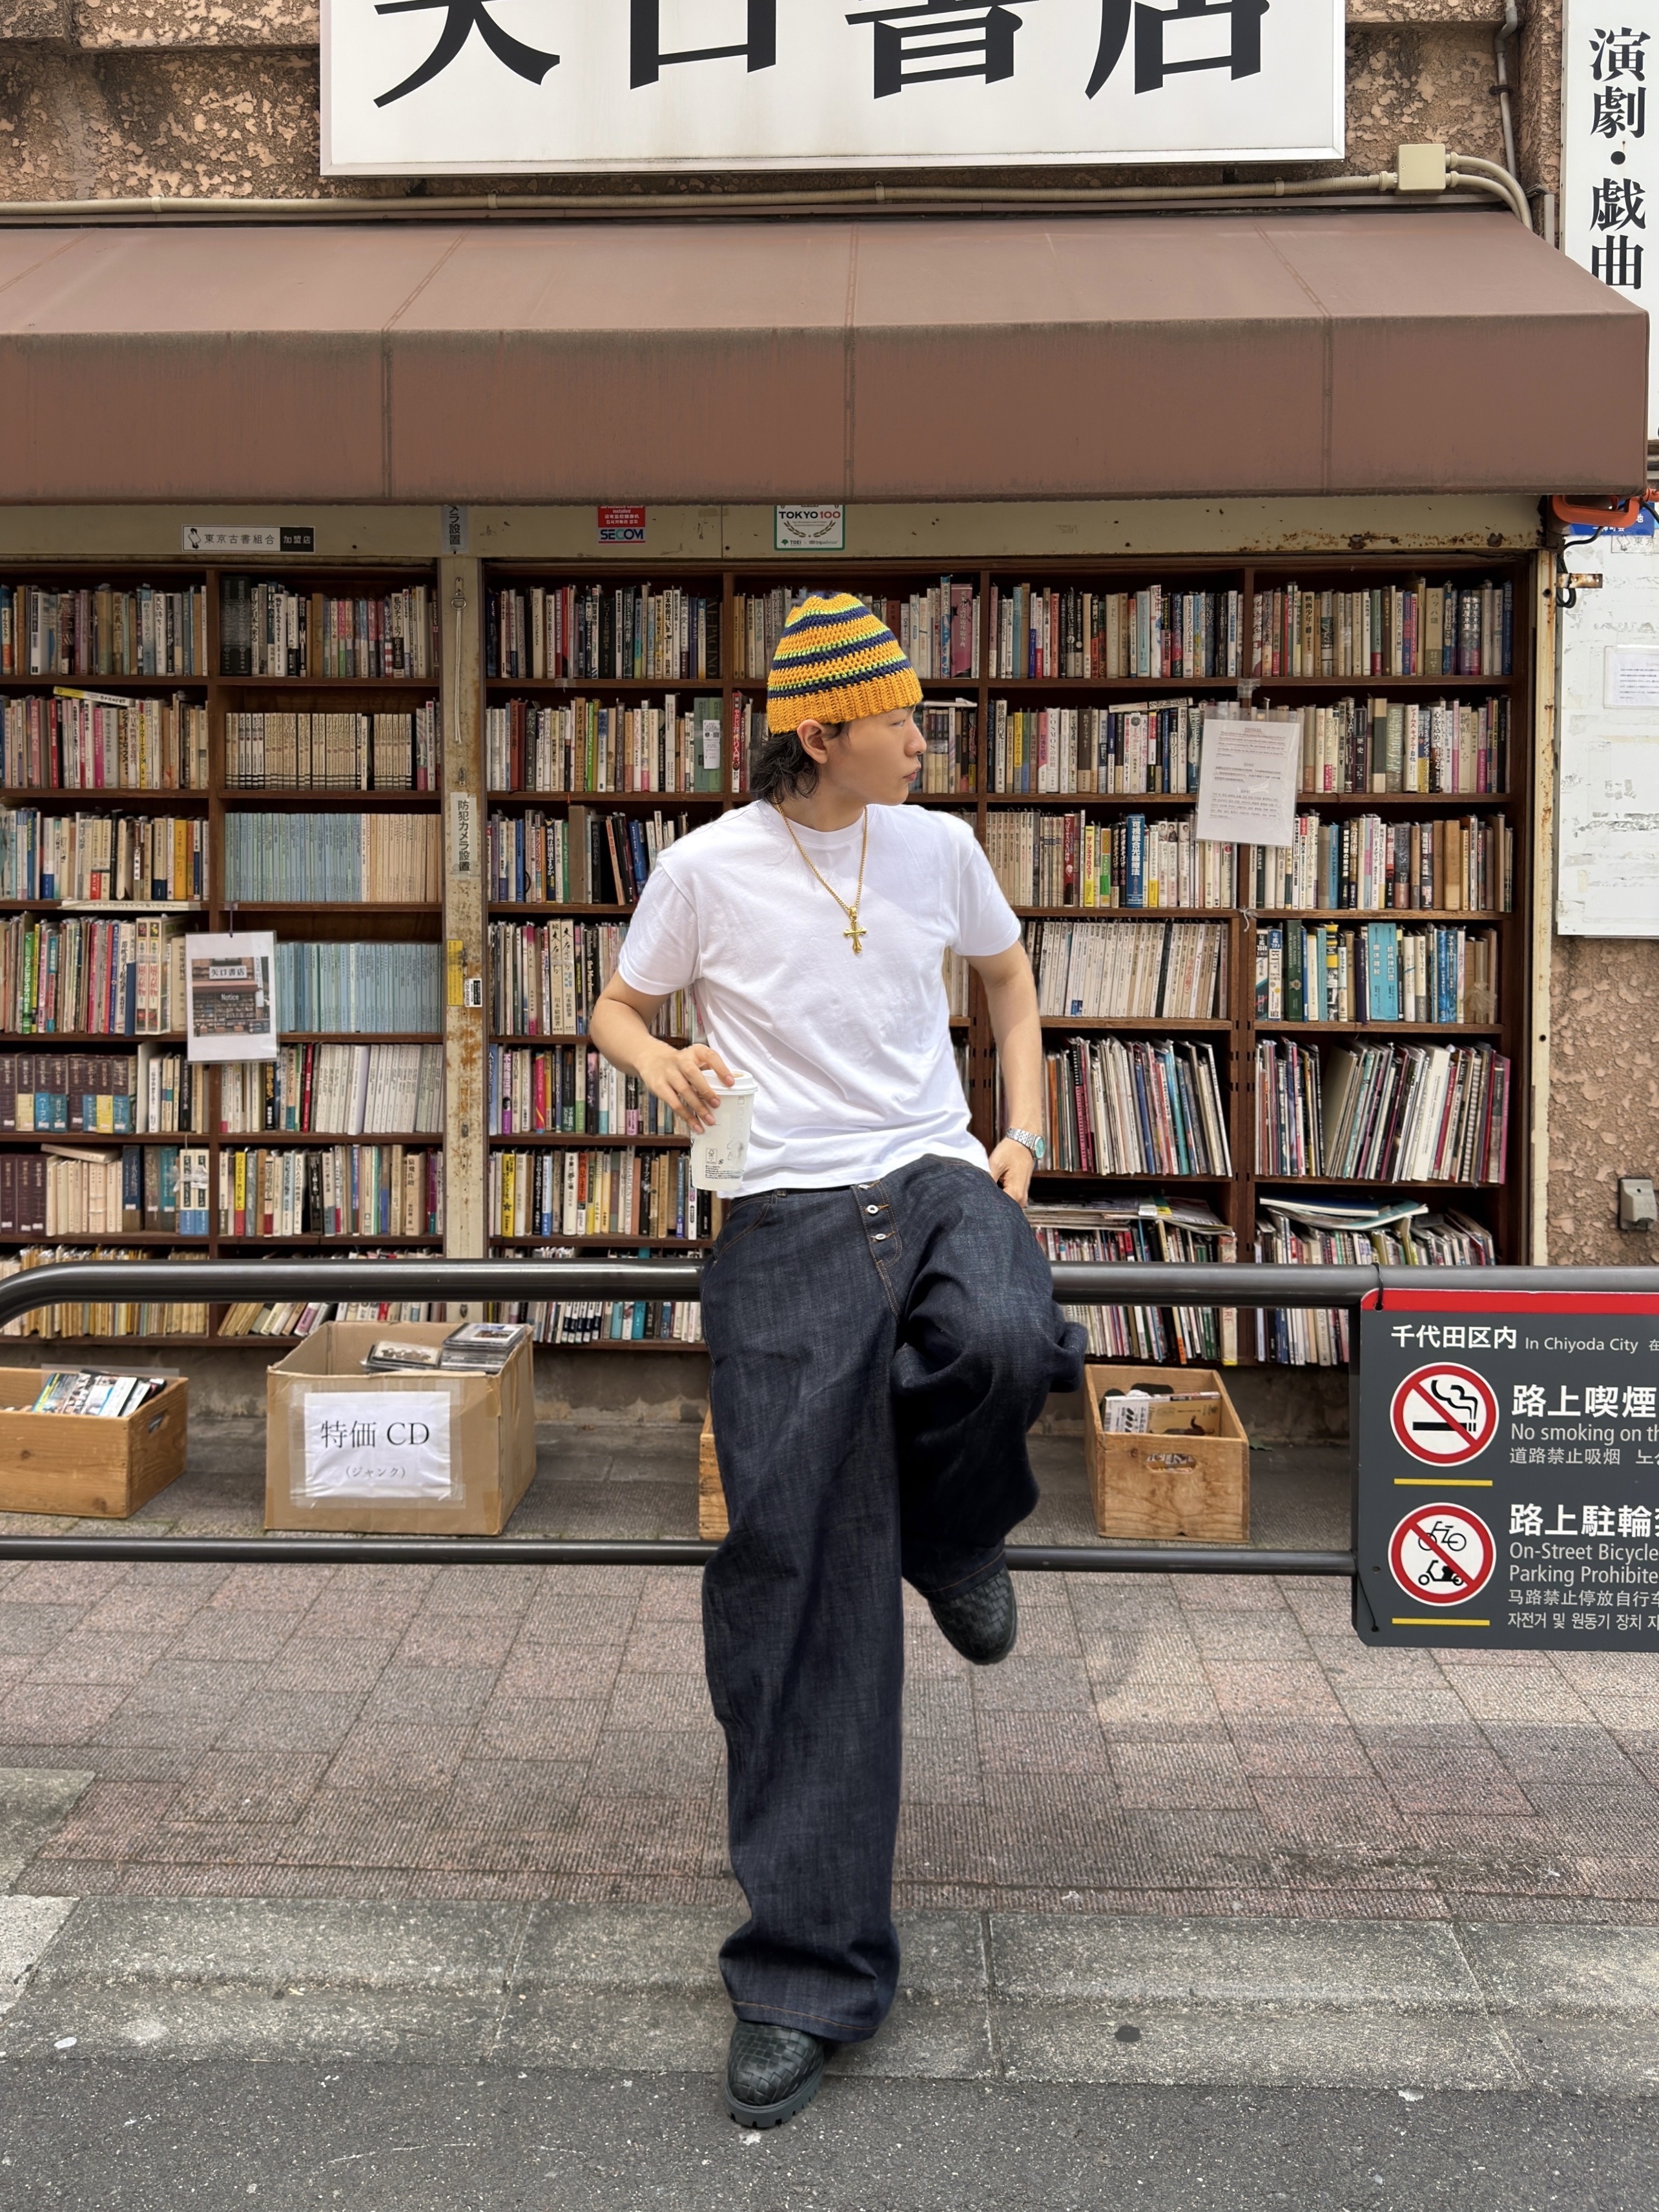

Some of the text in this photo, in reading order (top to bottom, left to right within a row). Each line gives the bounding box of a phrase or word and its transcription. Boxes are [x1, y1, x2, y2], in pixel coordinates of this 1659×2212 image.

[1588, 26, 1651, 290] 演劇・戯曲
[778, 511, 841, 519] TOKYO 100
[204, 533, 311, 546] 東京古書組合 加盟店
[600, 528, 644, 540] SECOM
[1634, 536, 1659, 546] 東京
[1304, 595, 1313, 623] 映画少年
[458, 800, 471, 872] 防犯カメラ設置
[1131, 821, 1141, 876] 可視総合光線療法
[211, 967, 245, 977] 矢口書店
[221, 993, 240, 1001] Notice
[1390, 1324, 1518, 1349] 千代田区内
[1525, 1336, 1639, 1355] In Chiyoda City
[1511, 1384, 1657, 1418] 路上喫煙
[320, 1420, 430, 1449] 特価 CD
[1510, 1423, 1536, 1440] No
[1540, 1423, 1615, 1446] smoking
[1620, 1428, 1642, 1442] on
[1509, 1447, 1621, 1465] 道路禁止吸烟
[345, 1466, 406, 1479] (ジャンク)
[1509, 1503, 1659, 1538] 路上駐輪
[1509, 1541, 1659, 1566] On-Street Bicycle
[1509, 1564, 1575, 1587] Parking
[1507, 1612, 1547, 1629] 자전거
[1552, 1612, 1565, 1629] 및
[1571, 1612, 1610, 1630] 원동기
[1616, 1613, 1642, 1631] 장치
